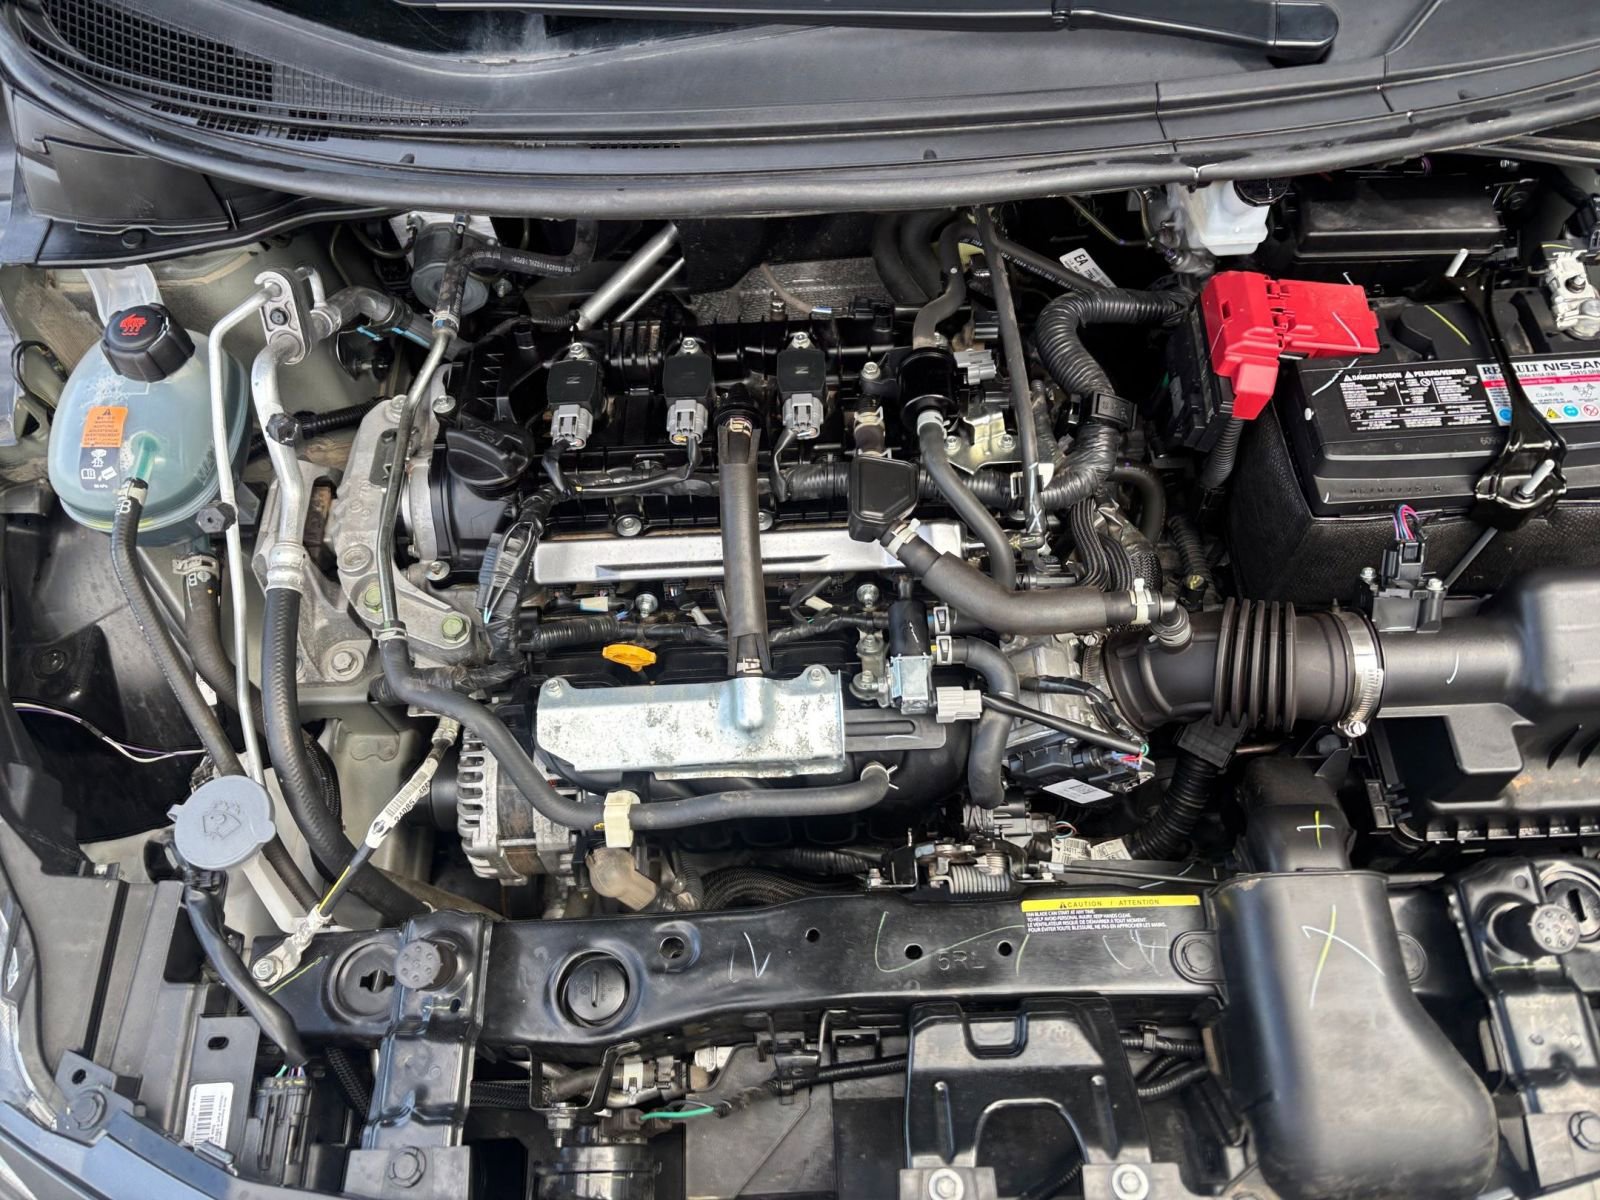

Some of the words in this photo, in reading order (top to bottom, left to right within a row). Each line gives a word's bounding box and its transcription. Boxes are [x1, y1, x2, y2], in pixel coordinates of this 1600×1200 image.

[1074, 254, 1088, 266] EA
[1482, 364, 1538, 375] REULT
[119, 499, 132, 514] B
